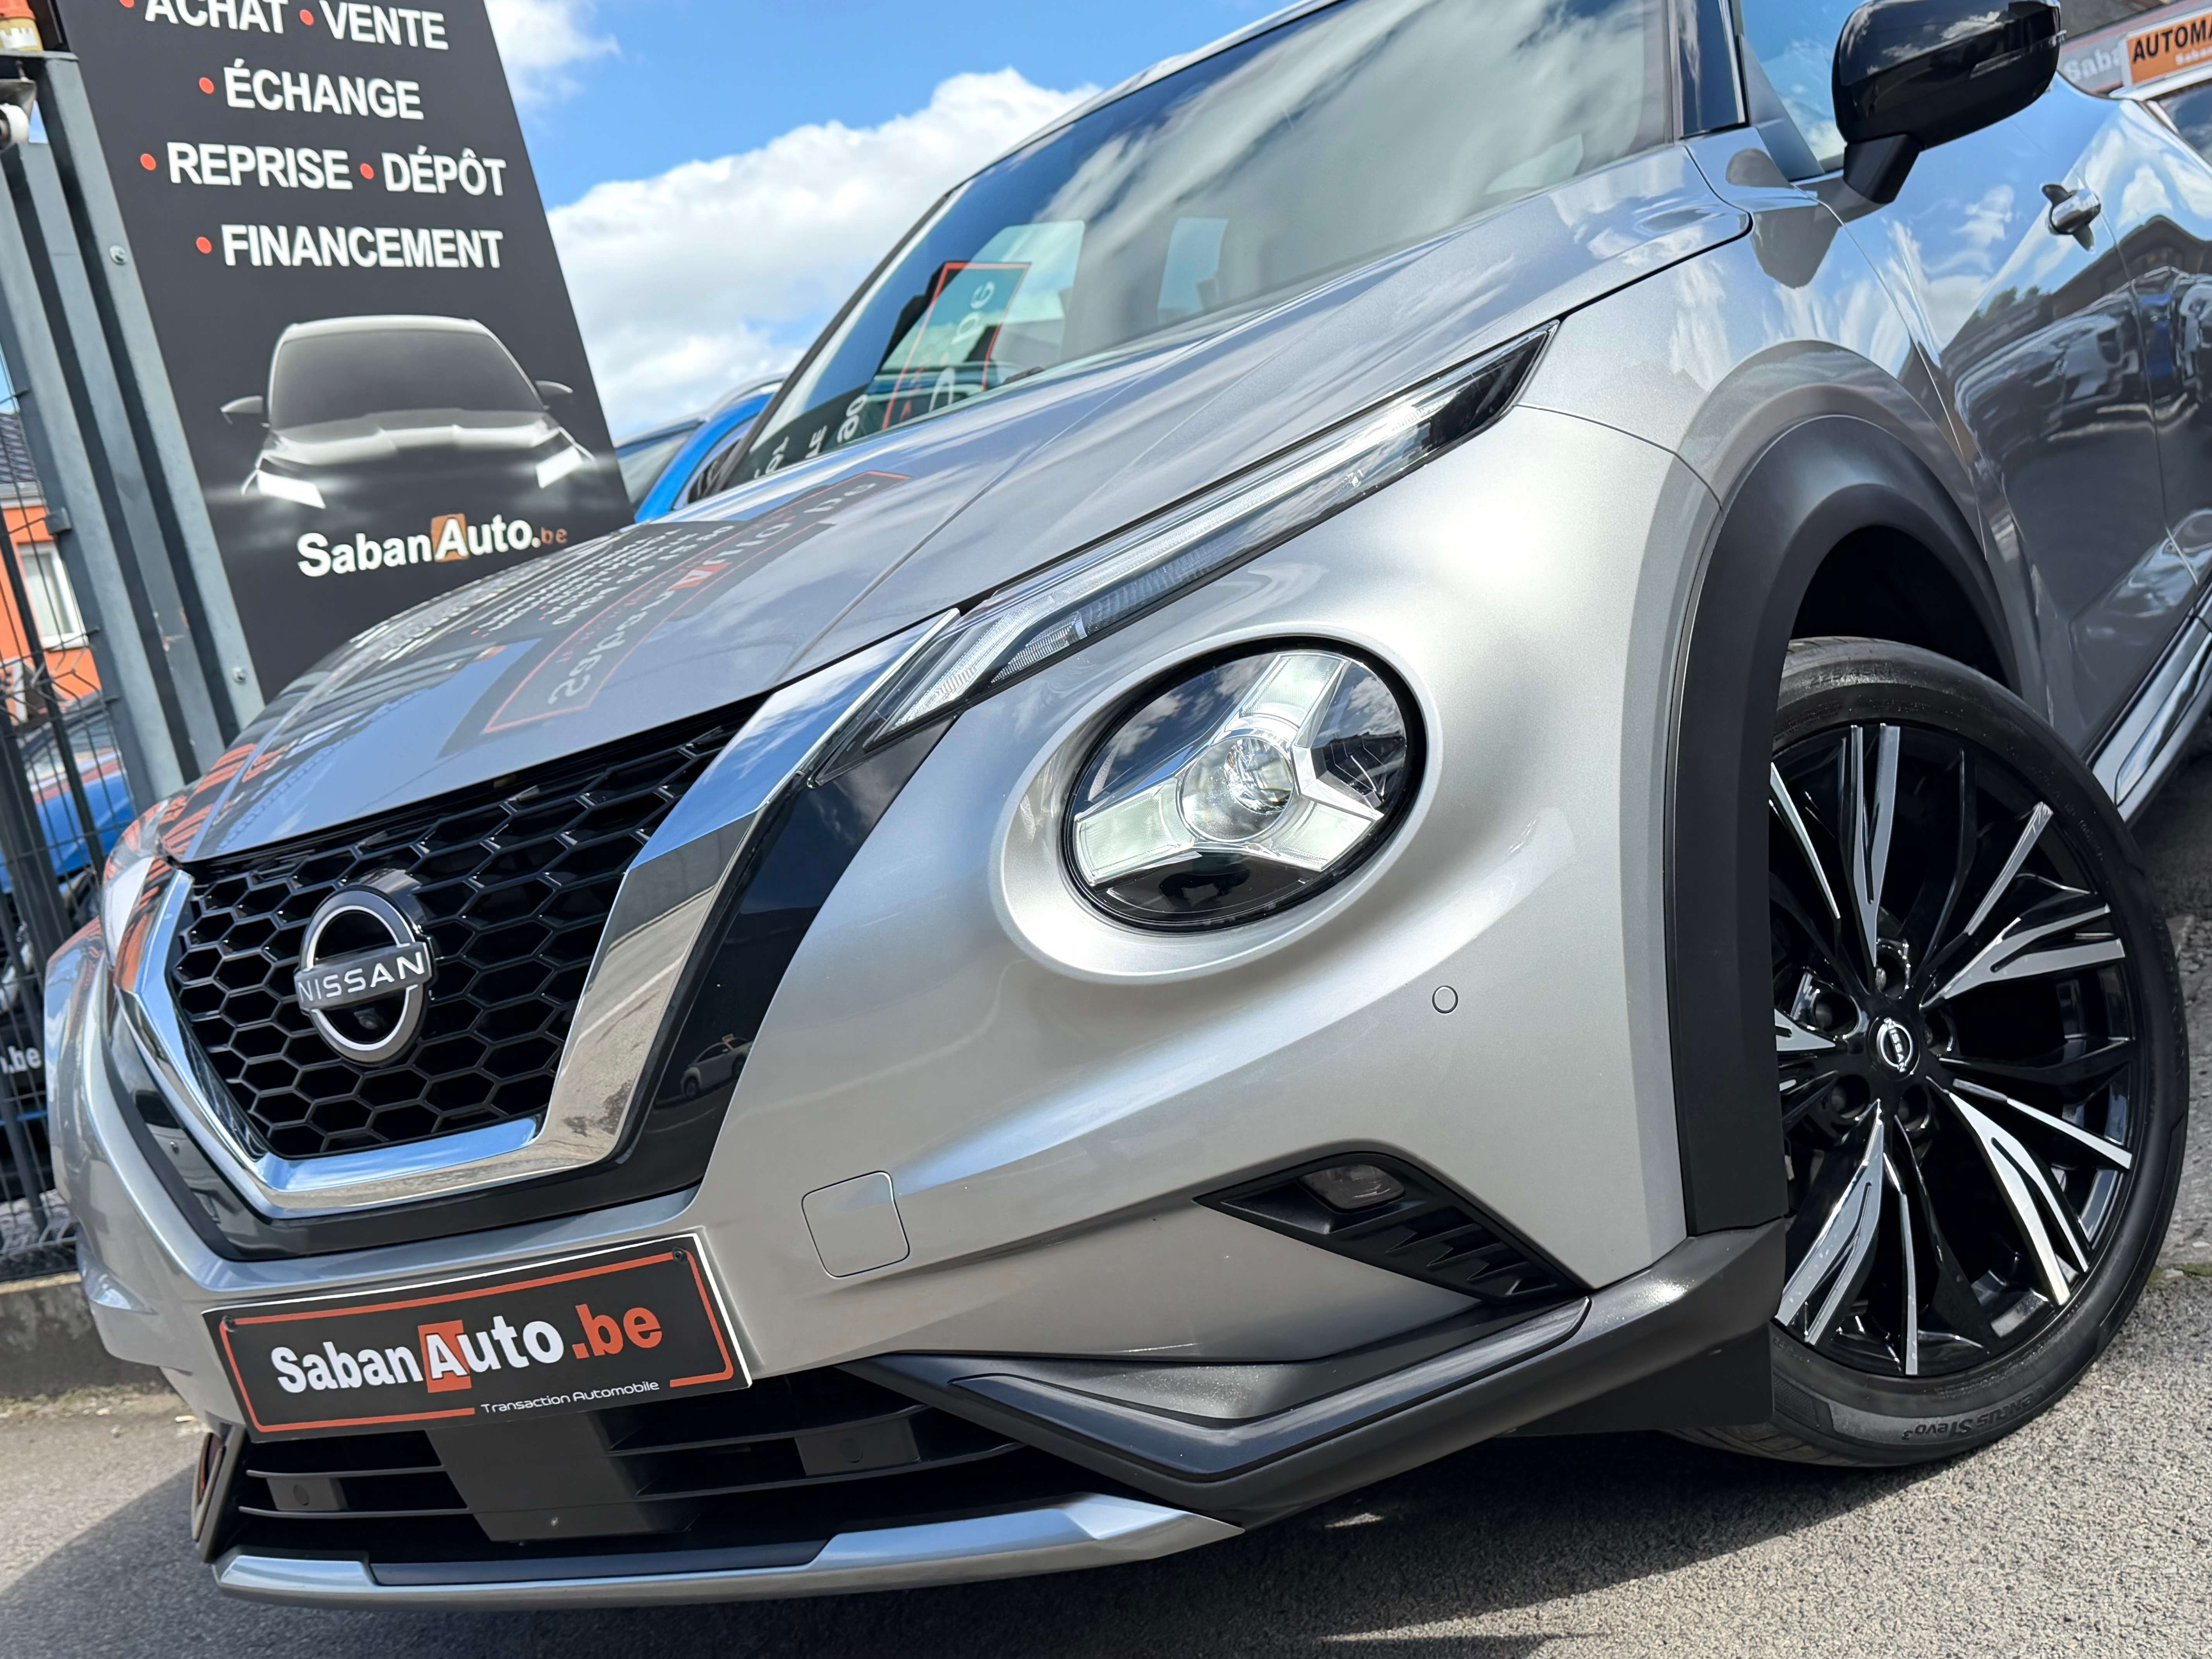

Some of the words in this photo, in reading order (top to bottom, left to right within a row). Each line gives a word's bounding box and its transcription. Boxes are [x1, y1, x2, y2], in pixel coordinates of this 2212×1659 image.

[145, 0, 289, 34] ACHAT
[319, 0, 449, 50] VENTE
[223, 58, 424, 120] ÉCHANGE
[167, 142, 353, 190] REPRISE
[381, 145, 506, 196] DÉPÔT
[221, 224, 503, 268] FINANCEMENT
[297, 514, 568, 577] SabanAuto.be
[297, 951, 425, 1002] NISSAN
[1884, 1018, 1906, 1072] NISSAN
[271, 1304, 663, 1393] SabanAuto.be
[481, 1395, 571, 1413] Transaction
[572, 1381, 660, 1403] Automobile
